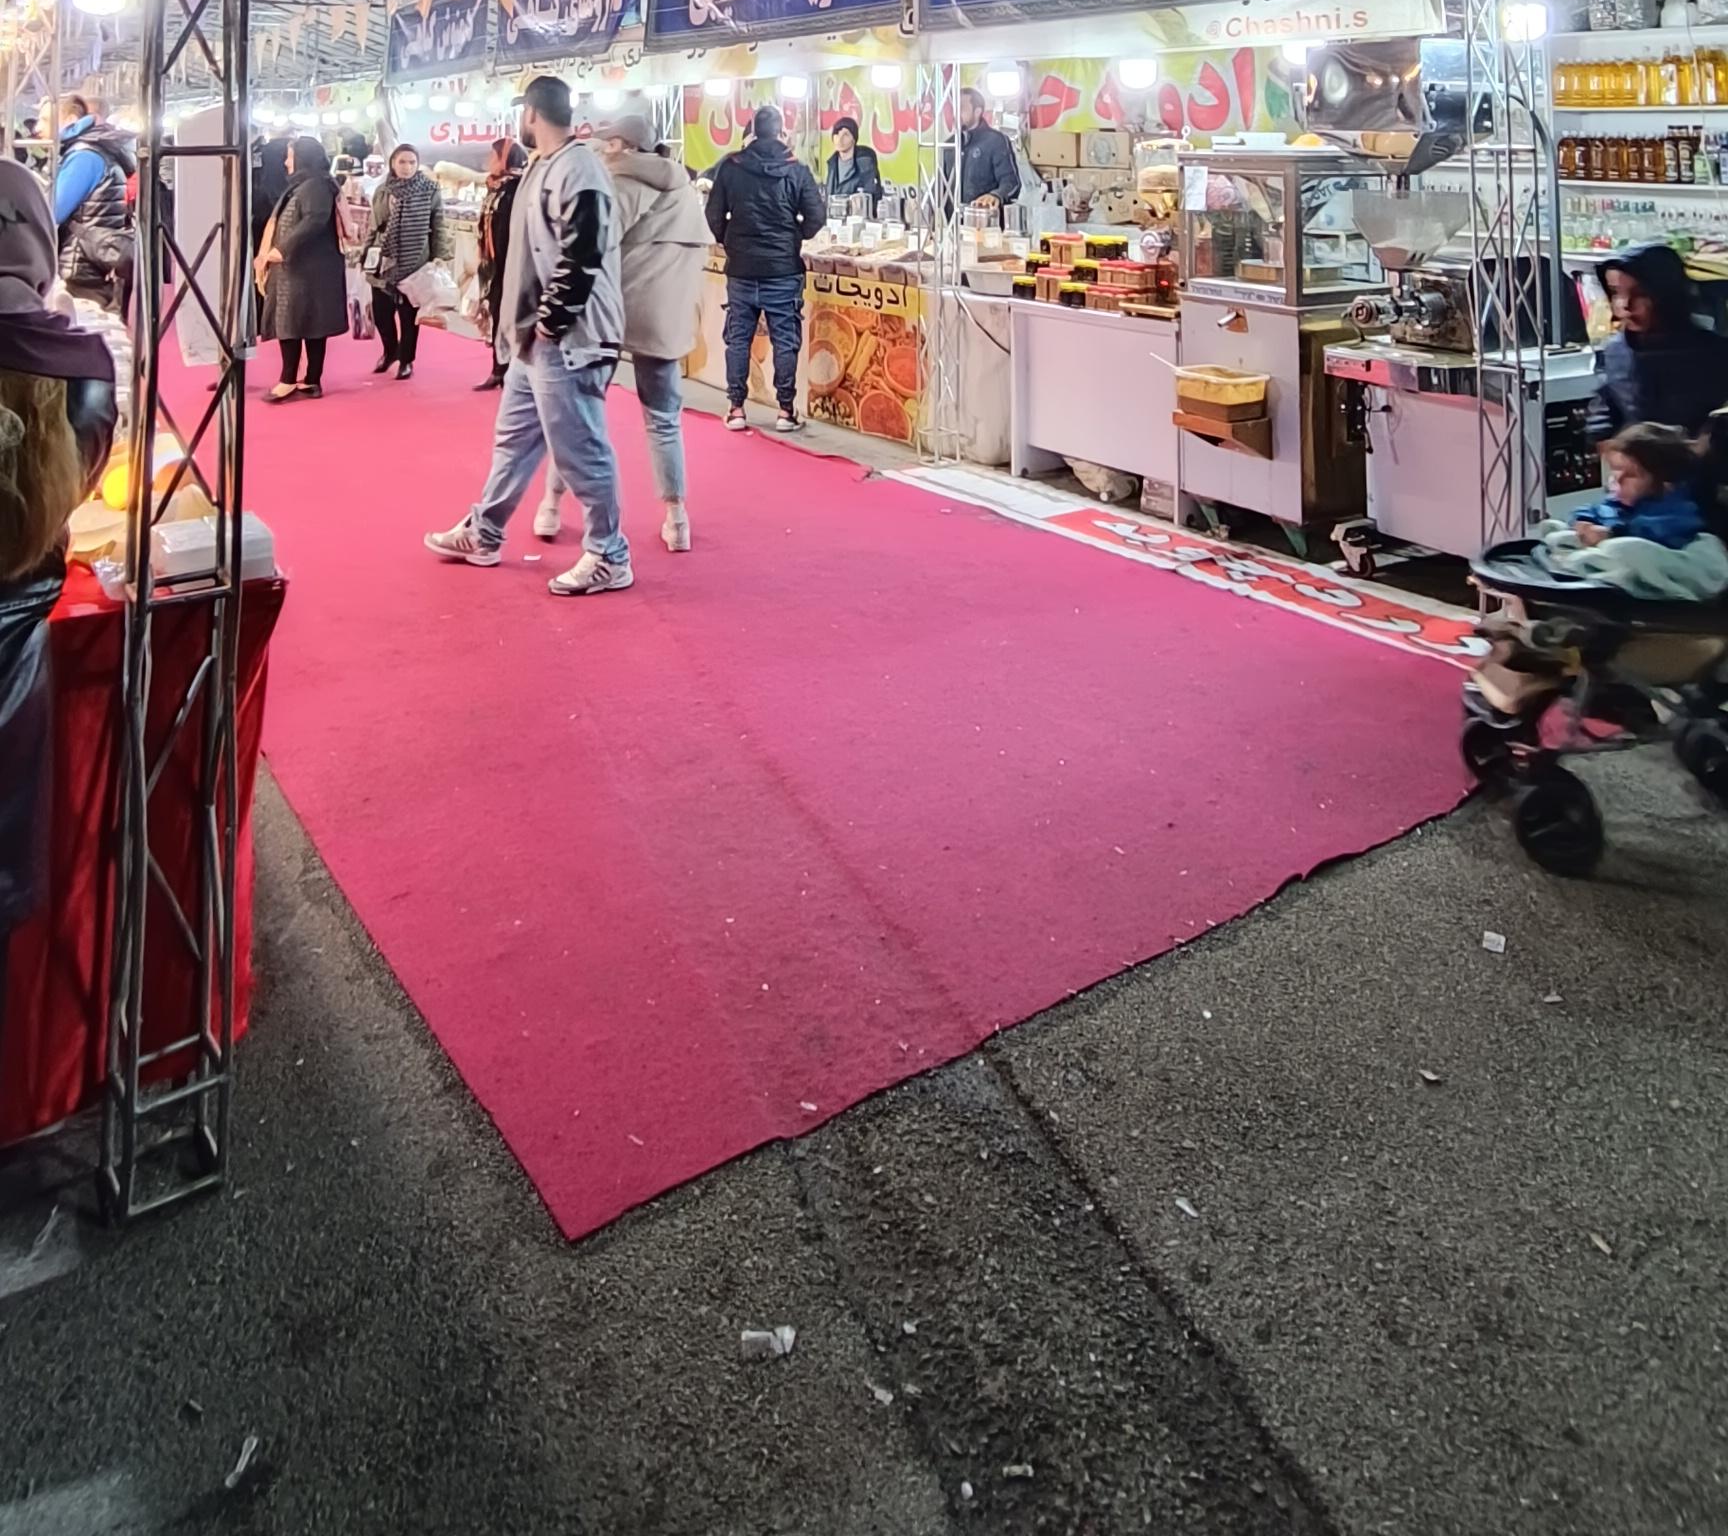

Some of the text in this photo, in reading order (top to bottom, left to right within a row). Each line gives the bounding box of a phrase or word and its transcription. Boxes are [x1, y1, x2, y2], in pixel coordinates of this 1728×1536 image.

[1205, 7, 1369, 39] @Chashni.s
[1094, 47, 1256, 137] ادوه
[813, 274, 908, 310] ادویجات
